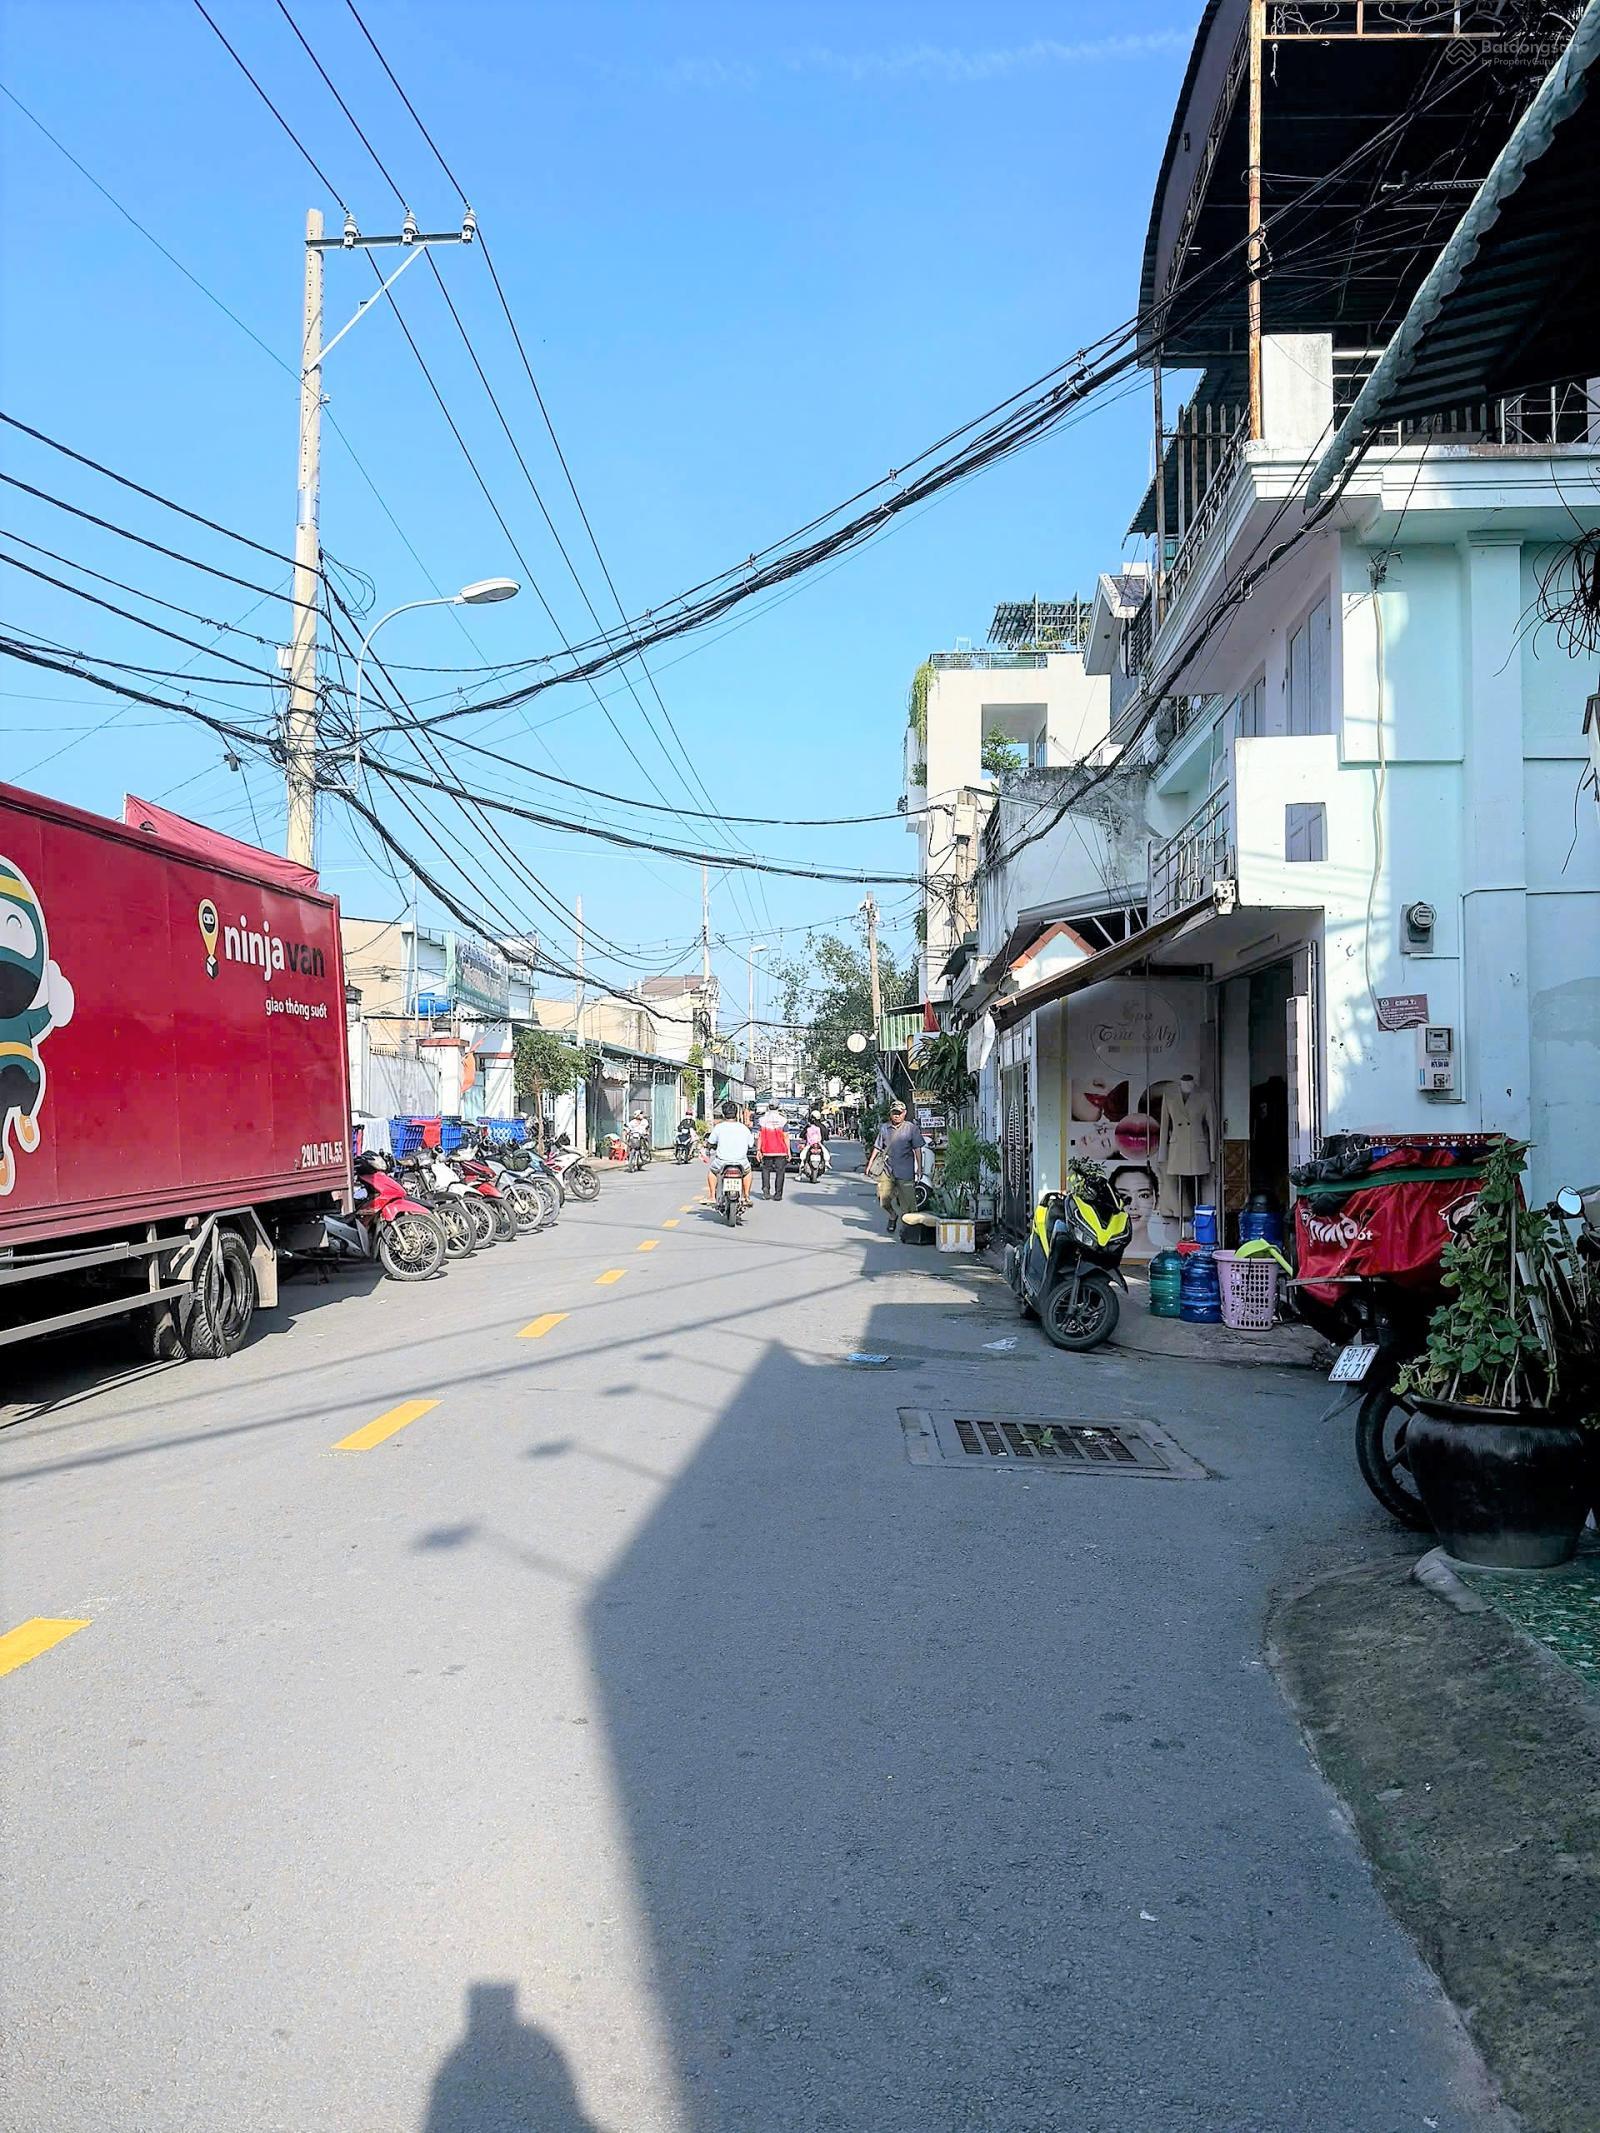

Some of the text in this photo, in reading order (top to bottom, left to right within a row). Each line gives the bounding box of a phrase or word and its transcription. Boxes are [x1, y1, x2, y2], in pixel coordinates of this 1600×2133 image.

[265, 997, 328, 1020] giao thông suốt
